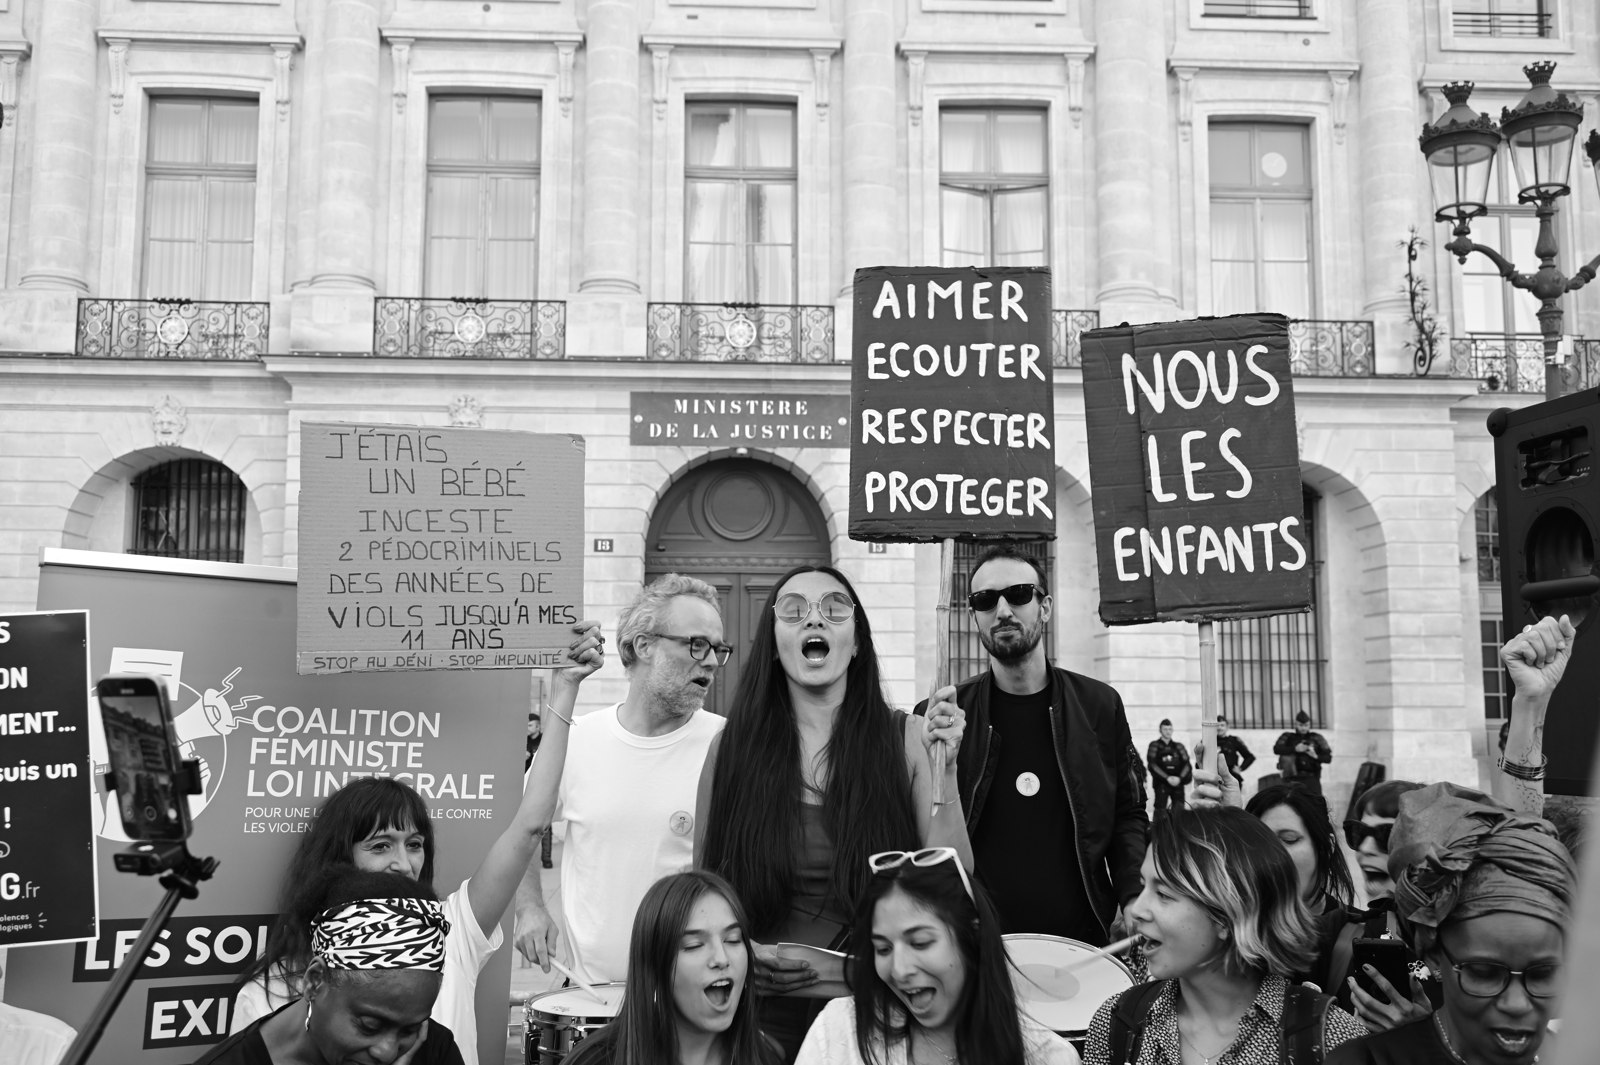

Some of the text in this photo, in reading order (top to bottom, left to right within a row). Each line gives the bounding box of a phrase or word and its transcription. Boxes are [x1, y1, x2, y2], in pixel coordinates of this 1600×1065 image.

[872, 280, 1028, 322] AIMER
[867, 342, 1046, 381] ECOUTER
[1122, 344, 1280, 414] NOUS
[674, 398, 809, 416] MINISTERE
[650, 423, 833, 441] DE LA JUSTICE
[861, 408, 1051, 450] RESPECTER
[369, 460, 526, 497] UN BÉBÉ
[1147, 427, 1253, 503] LES
[865, 471, 1054, 519] PROTEGER
[359, 508, 513, 533] INCESTE
[338, 541, 353, 562] 2
[597, 540, 610, 551] 13
[1113, 516, 1306, 581] ENFANTS
[327, 567, 553, 595] DES ANNÉES DE
[538, 605, 577, 625] MES
[400, 628, 504, 650] 11 ANS
[313, 656, 359, 670] STOP
[366, 656, 387, 668] AU
[448, 654, 484, 666] STOP
[252, 705, 441, 738] COALITION
[249, 732, 424, 768] FÉMINISTE
[45, 762, 78, 779] un
[246, 765, 495, 800] LOI INRALE
[245, 807, 282, 818] POUR
[285, 807, 310, 818] UNE
[445, 808, 493, 819] CONTRE
[243, 822, 266, 833] LES
